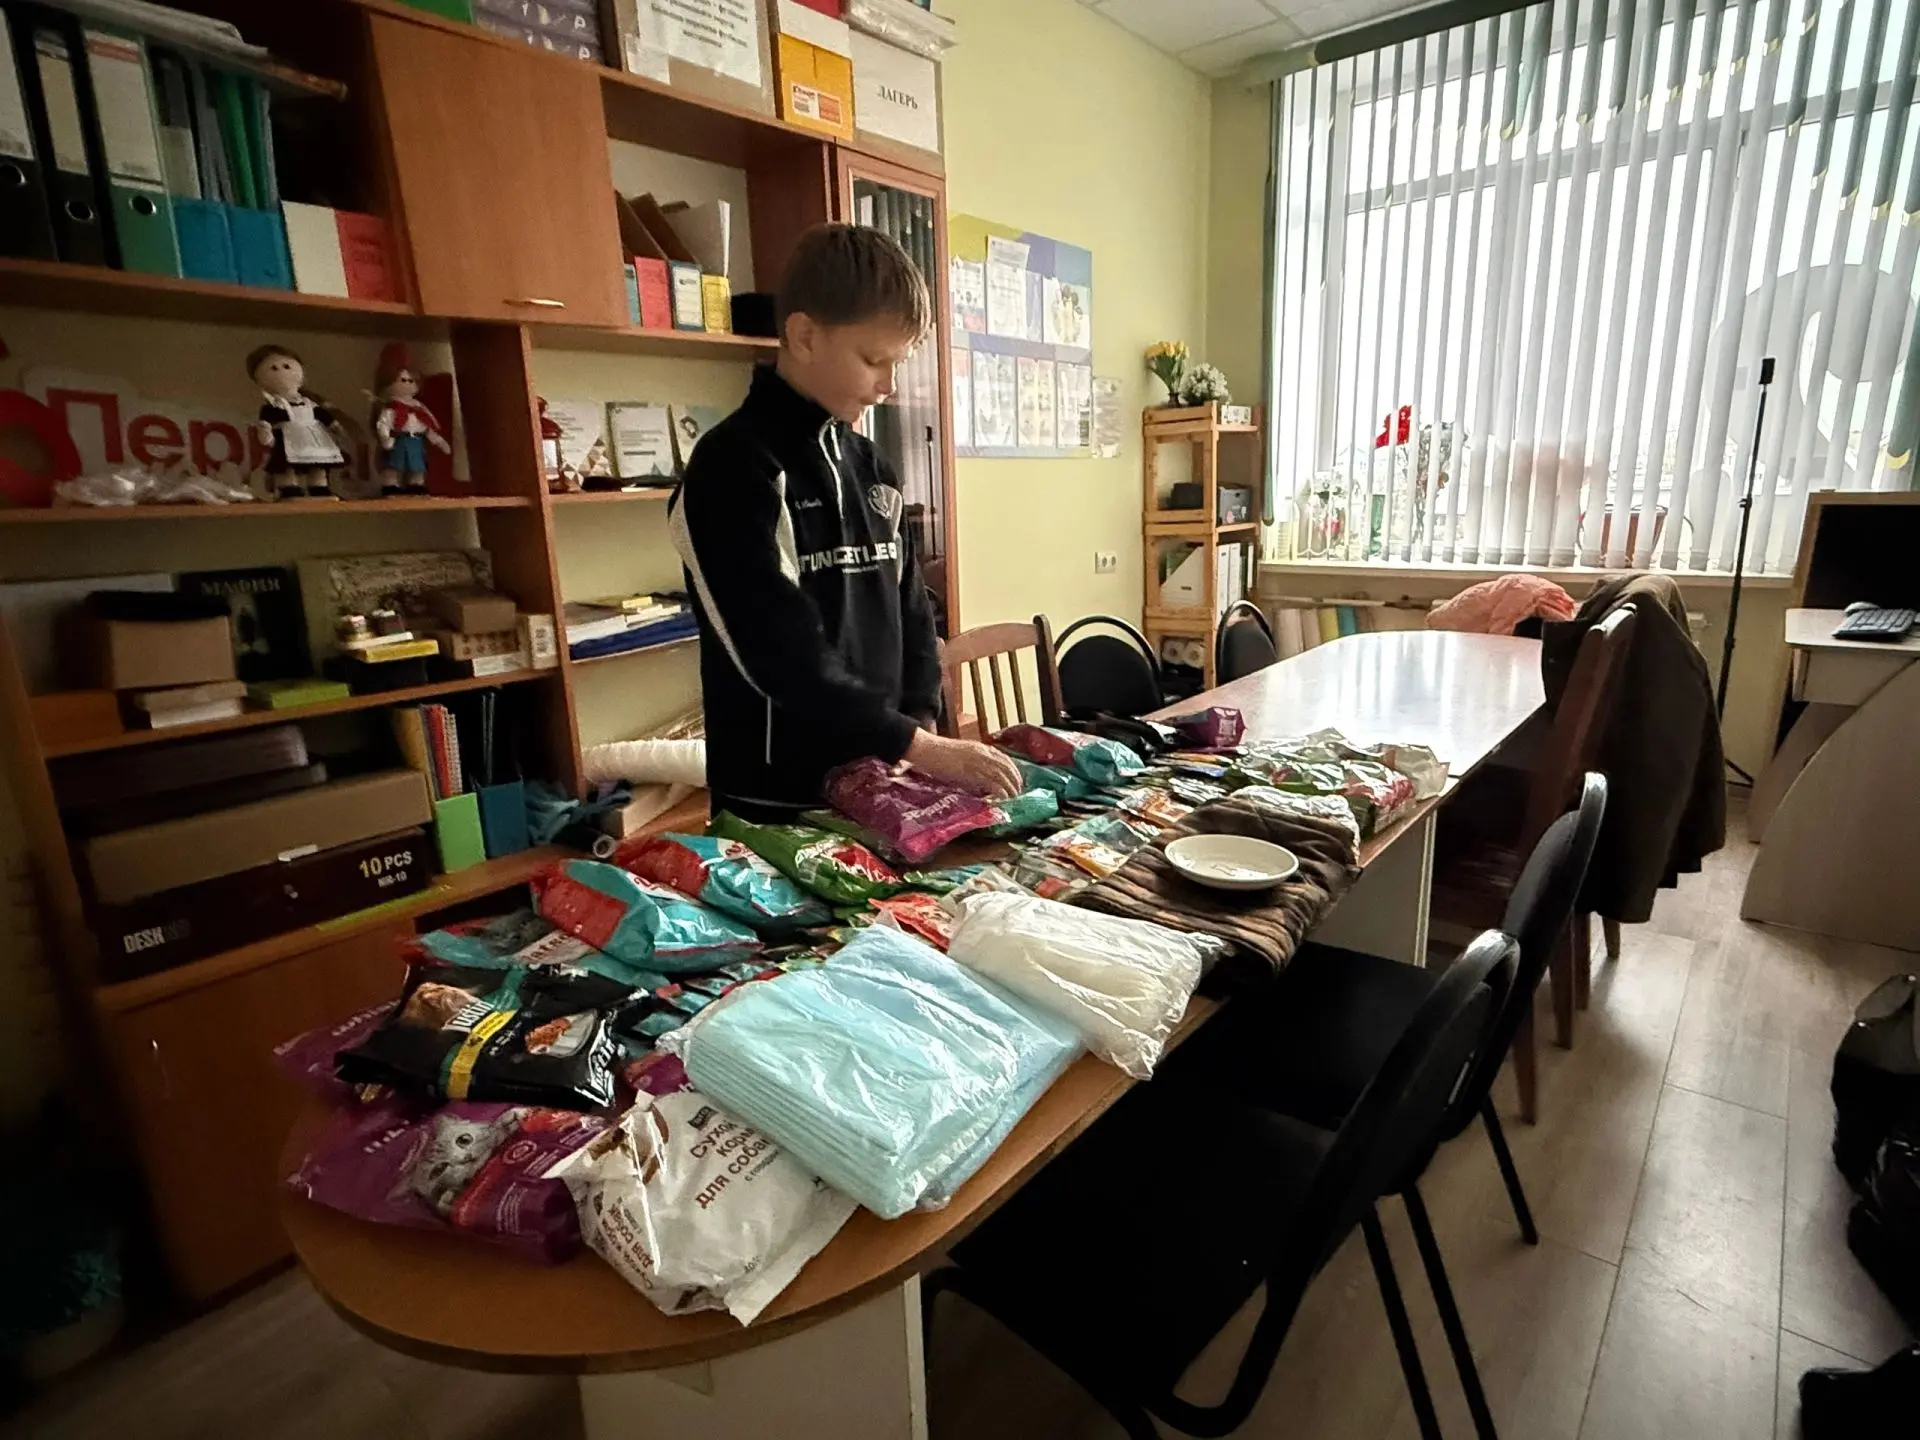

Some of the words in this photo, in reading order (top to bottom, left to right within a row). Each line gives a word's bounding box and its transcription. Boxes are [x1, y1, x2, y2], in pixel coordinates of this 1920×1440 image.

[877, 86, 918, 109] ЛАГЕРЬ
[46, 386, 278, 477] Пер
[359, 857, 382, 878] 10
[384, 851, 413, 870] PCS
[695, 1174, 731, 1209] для
